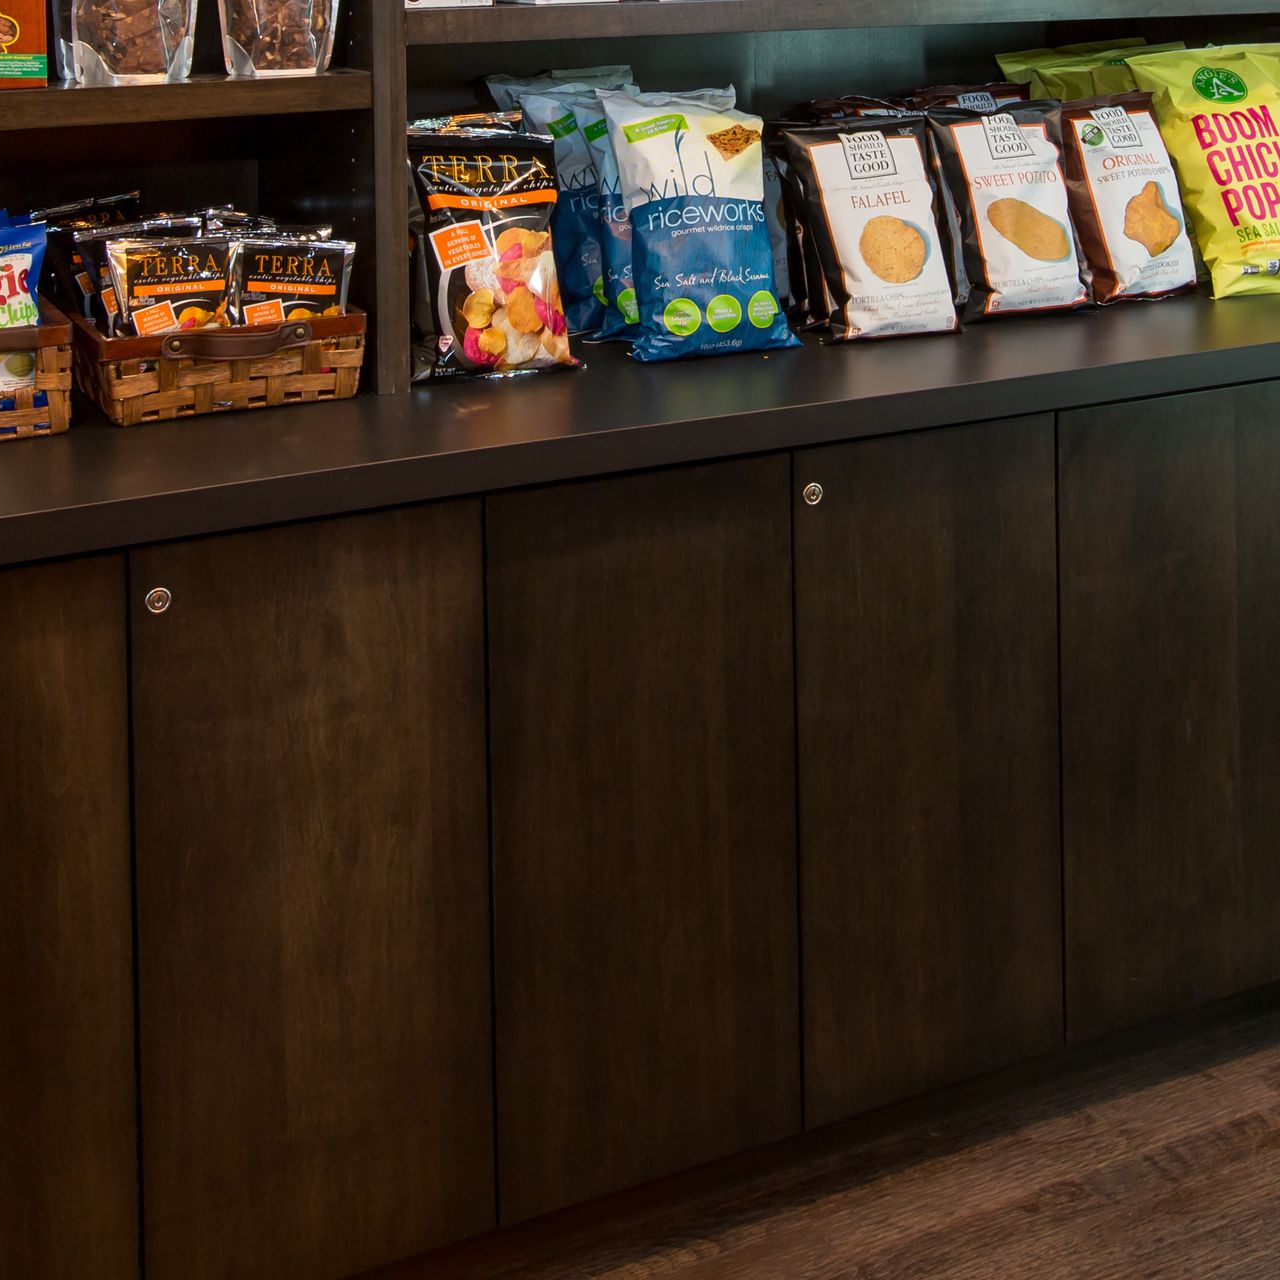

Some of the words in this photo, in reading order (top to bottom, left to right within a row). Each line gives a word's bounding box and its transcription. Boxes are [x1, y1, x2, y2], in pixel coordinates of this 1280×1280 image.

[961, 95, 990, 104] FOOD
[1095, 109, 1123, 121] FOOD
[1191, 105, 1280, 150] BOOM
[844, 134, 880, 143] FOOD
[848, 142, 884, 152] SHOULD
[995, 142, 1028, 154] GOOD
[850, 151, 887, 162] TASTE
[1102, 153, 1159, 170] ORIGINAL
[854, 161, 889, 174] GOOD
[974, 172, 1014, 190] SWEET
[1019, 170, 1057, 184] POTATO
[850, 191, 911, 209] FALAFEL
[648, 202, 765, 232] riceworks
[1236, 226, 1263, 243] SEA
[156, 283, 205, 293] ORIGINAL
[269, 284, 316, 293] ORIGINAL
